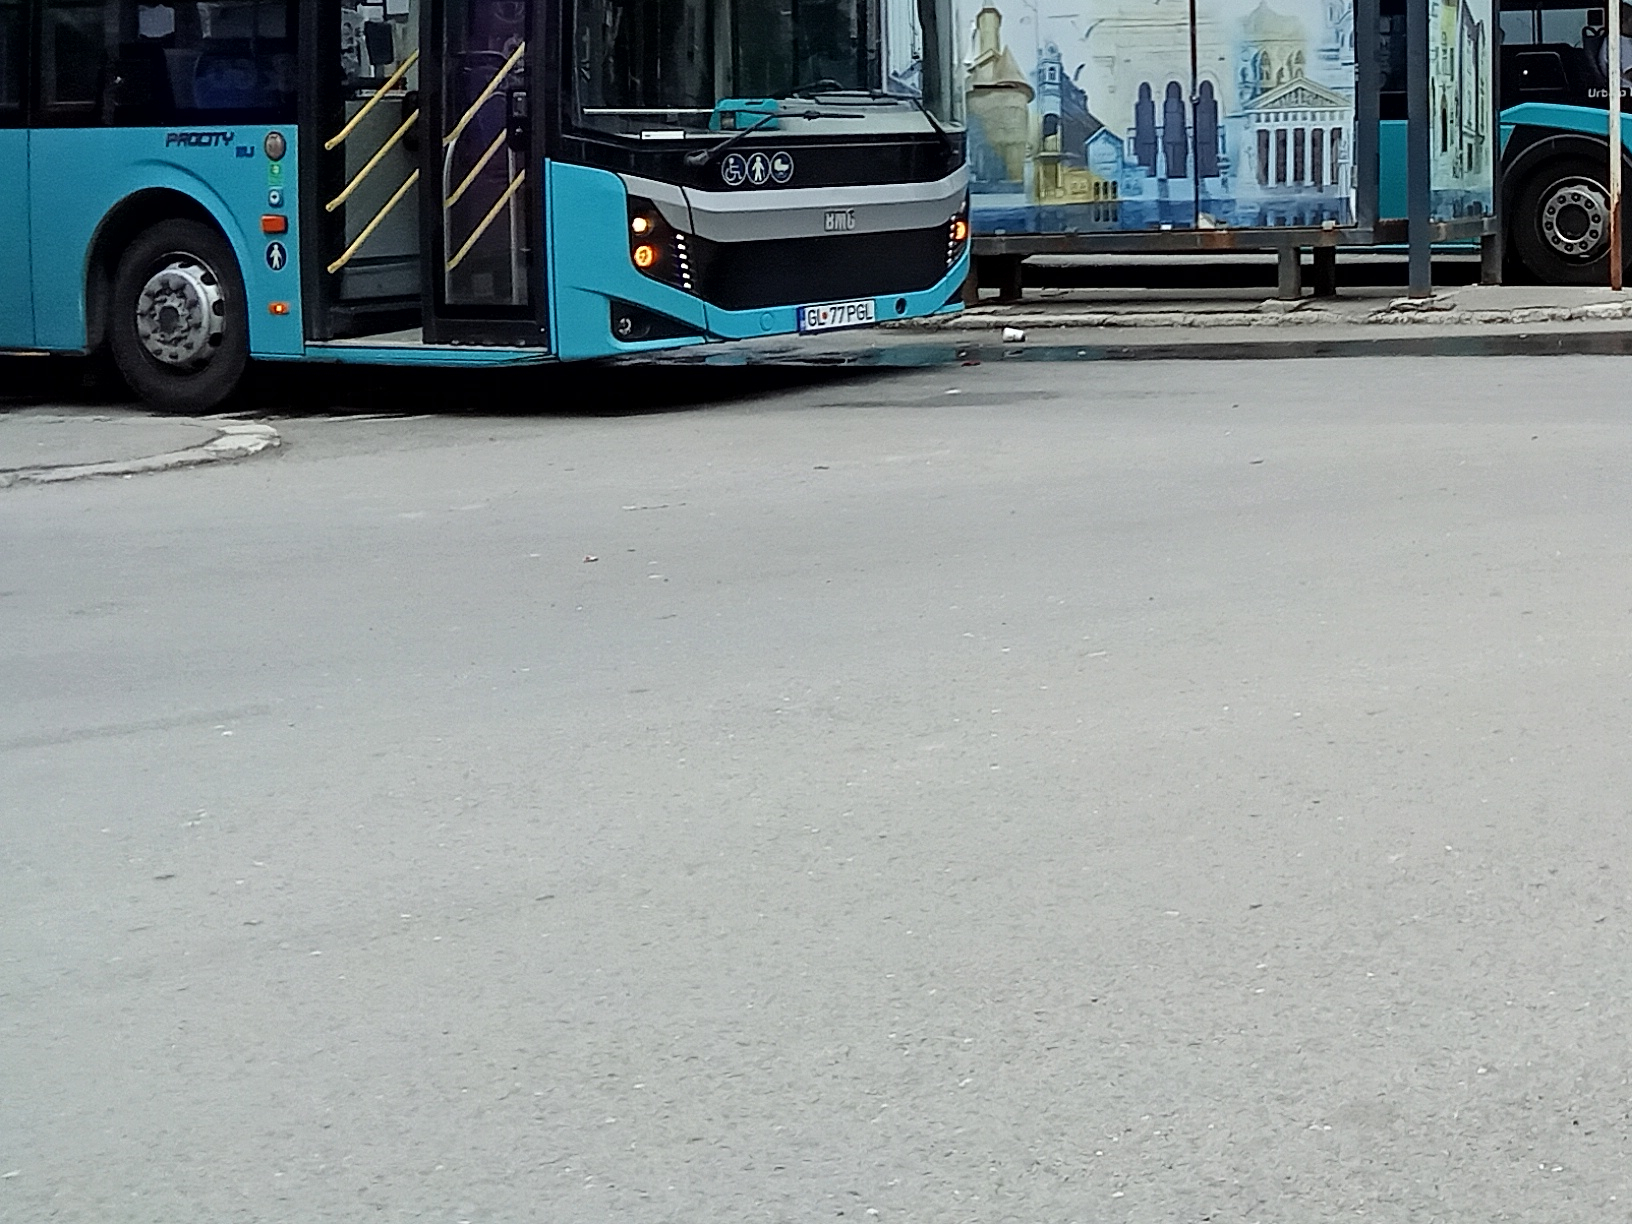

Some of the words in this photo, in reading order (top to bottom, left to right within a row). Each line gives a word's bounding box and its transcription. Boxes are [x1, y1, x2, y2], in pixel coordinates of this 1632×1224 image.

[1588, 88, 1627, 97] Urbo
[807, 309, 825, 326] GL
[847, 303, 873, 323] PGL
